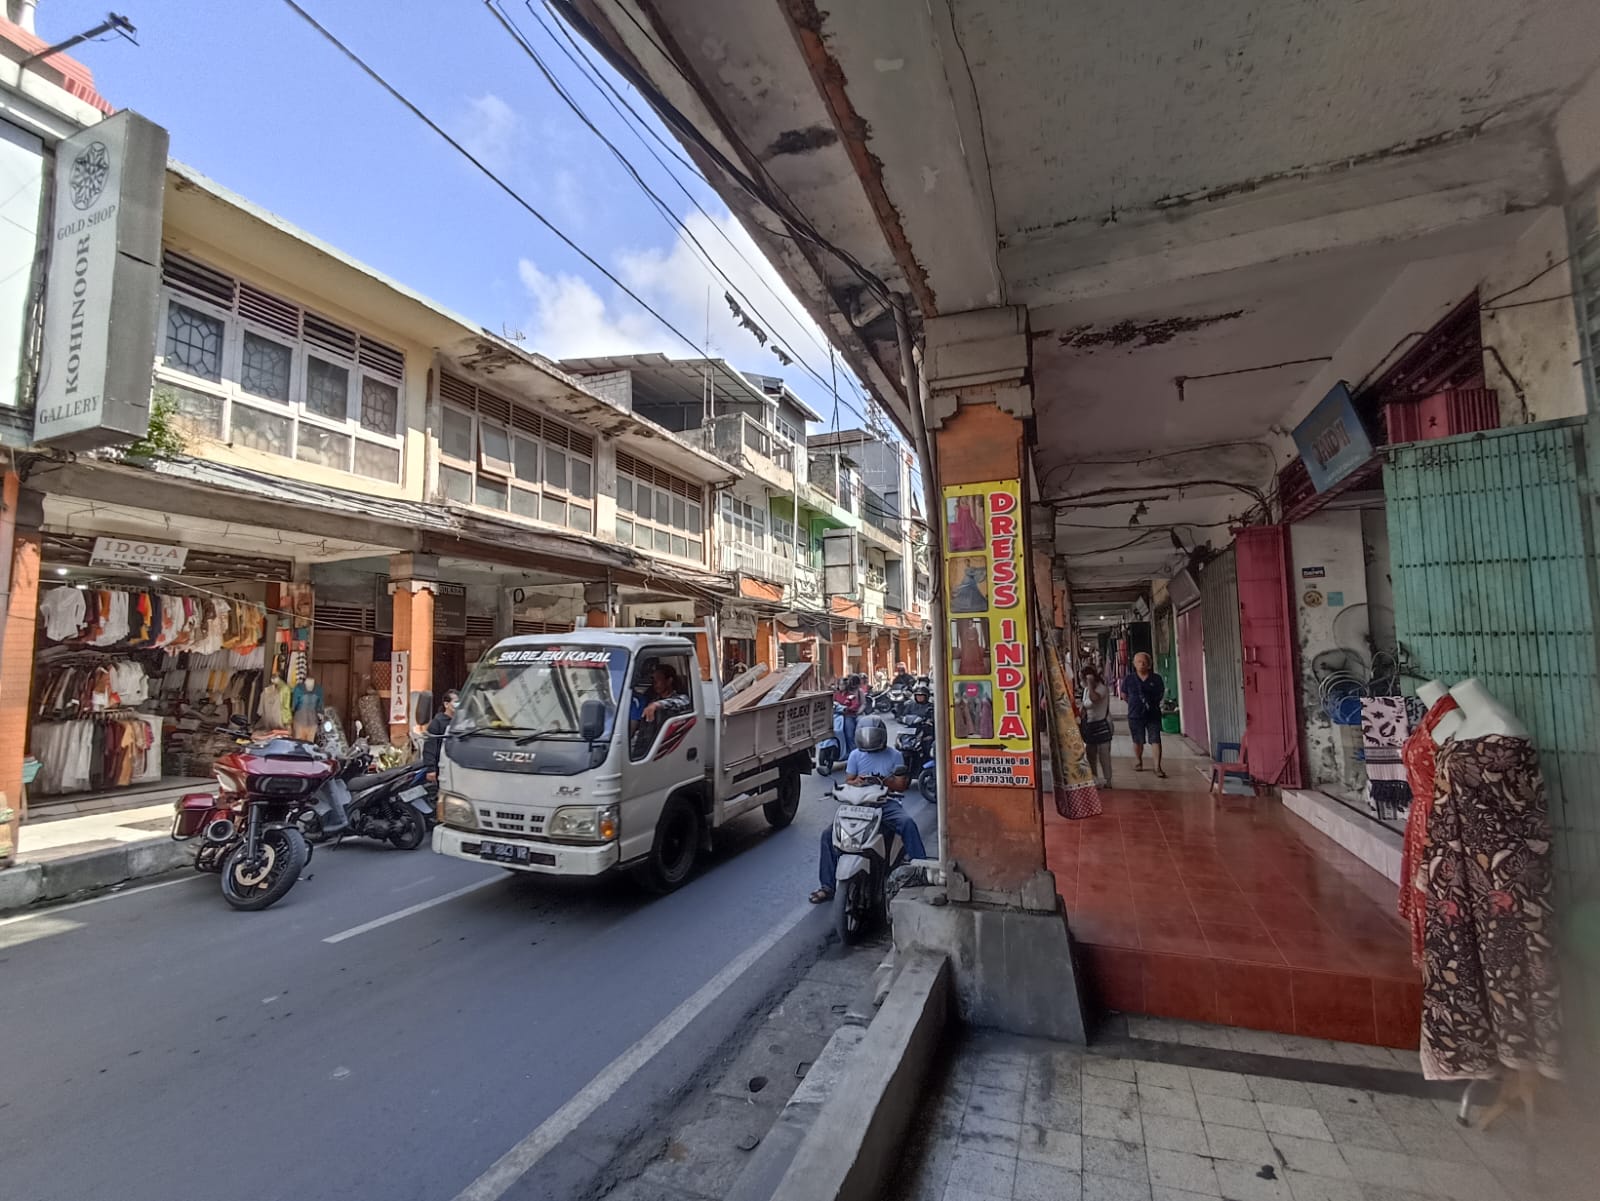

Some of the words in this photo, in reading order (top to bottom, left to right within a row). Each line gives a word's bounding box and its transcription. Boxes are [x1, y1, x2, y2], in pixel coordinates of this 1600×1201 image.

[56, 218, 85, 241] GOLD
[86, 204, 116, 228] SHOP
[65, 233, 91, 395] KOHINOOR
[39, 394, 99, 425] GALLERY
[103, 540, 178, 559] IDOLA
[989, 492, 1017, 608] DRESS
[499, 650, 522, 662] SRI
[520, 650, 565, 662] REJEKI
[564, 650, 611, 663] KAPAL
[396, 653, 404, 705] IDOLA
[995, 618, 1028, 739] INDIA
[966, 756, 1004, 765] SULAWESI
[973, 766, 1012, 774] DENPASAR
[985, 775, 998, 783] 797
[1015, 776, 1029, 784] 077
